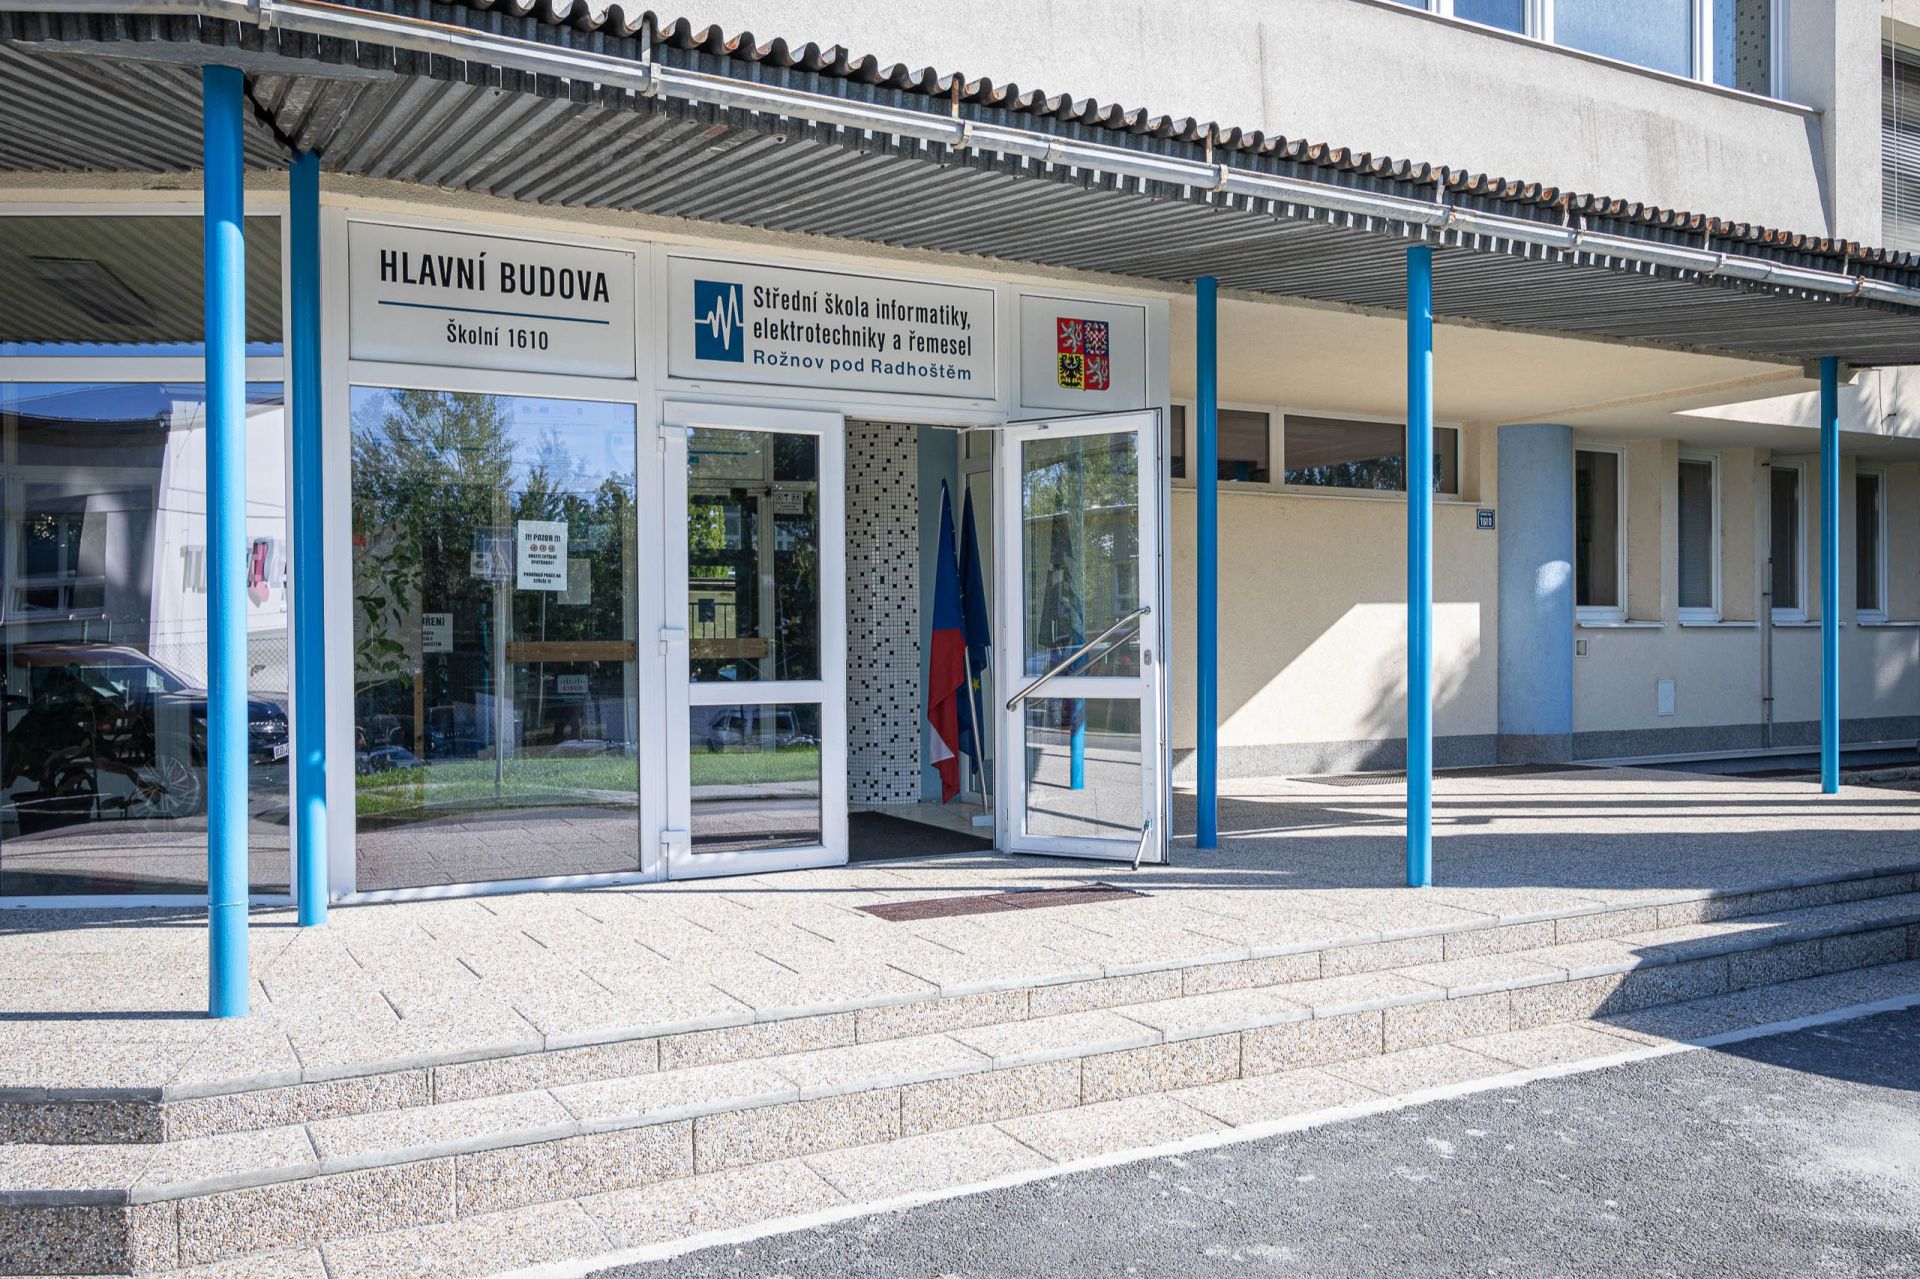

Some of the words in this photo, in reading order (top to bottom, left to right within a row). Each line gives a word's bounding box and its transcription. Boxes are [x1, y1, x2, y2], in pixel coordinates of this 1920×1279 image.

[380, 249, 488, 291] HLAVNÍ
[500, 262, 610, 303] BUDOVA
[753, 286, 818, 313] Střední
[824, 292, 870, 318] škola
[876, 297, 971, 331] informatiky,
[446, 318, 499, 346] Školní
[508, 328, 549, 350] 1610
[753, 318, 886, 353] elektrotechniky
[893, 333, 902, 351] a
[909, 329, 972, 357] řemesel
[753, 349, 824, 370] Rožnov
[830, 357, 865, 374] pod
[871, 359, 972, 381] Radhoštěm
[533, 534, 553, 542] POZOR
